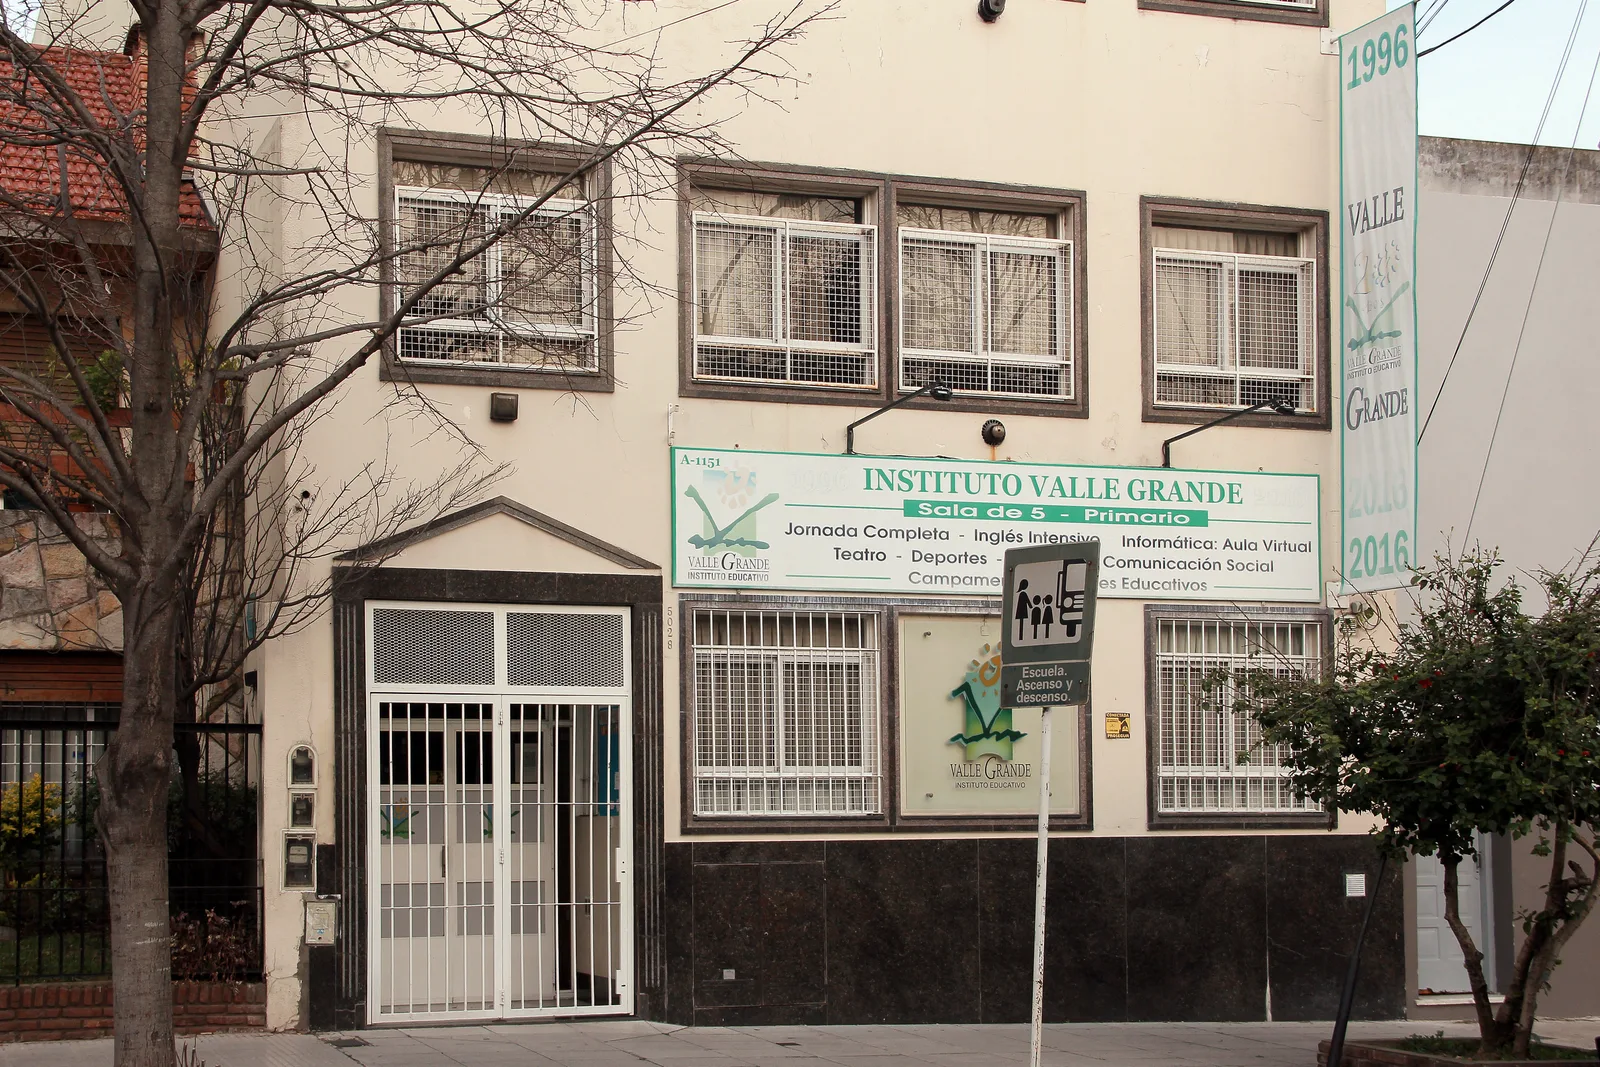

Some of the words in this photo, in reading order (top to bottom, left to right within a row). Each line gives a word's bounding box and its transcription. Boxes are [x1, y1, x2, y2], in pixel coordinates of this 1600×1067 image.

[1347, 23, 1408, 91] 1996
[1348, 186, 1405, 236] VALLE
[1347, 354, 1366, 369] VALLE
[1368, 345, 1402, 364] GRANDE
[1347, 367, 1373, 380] INSTITUTO
[1373, 360, 1402, 374] EDUCATIVO
[1346, 386, 1409, 431] GRANDE
[680, 454, 721, 468] A-1151
[863, 467, 1022, 497] INSTITUTO
[1028, 474, 1121, 500] VALLE
[1127, 479, 1244, 505] GRANDE
[918, 502, 978, 518] Sala
[986, 505, 1023, 520] de
[1030, 506, 1046, 520] 5
[1084, 508, 1191, 525] Primario
[784, 522, 859, 538] Jornada
[863, 524, 950, 542] Completa
[974, 529, 1024, 545] Inglés
[1122, 534, 1218, 550] Informática:
[1222, 538, 1258, 552] Aula
[1263, 539, 1312, 553] Virtual
[688, 556, 719, 569] VALLE
[721, 552, 770, 571] GRANDE
[834, 547, 887, 562] Teatro
[911, 549, 987, 566] Deportes
[1103, 555, 1222, 572] Comunicación
[1226, 558, 1274, 573] Social
[1349, 529, 1409, 580] 2016
[688, 571, 726, 581] INSTITUTO
[728, 573, 769, 582] EDUCATIVO
[908, 571, 1003, 588] Campame
[1122, 577, 1208, 593] Educativos
[1022, 665, 1068, 679] Escuela.
[1016, 679, 1063, 691] Ascenso
[1065, 679, 1073, 691] y
[1016, 691, 1071, 703] descenso.
[950, 763, 982, 778] VALLE
[984, 756, 1032, 780] GRANDE
